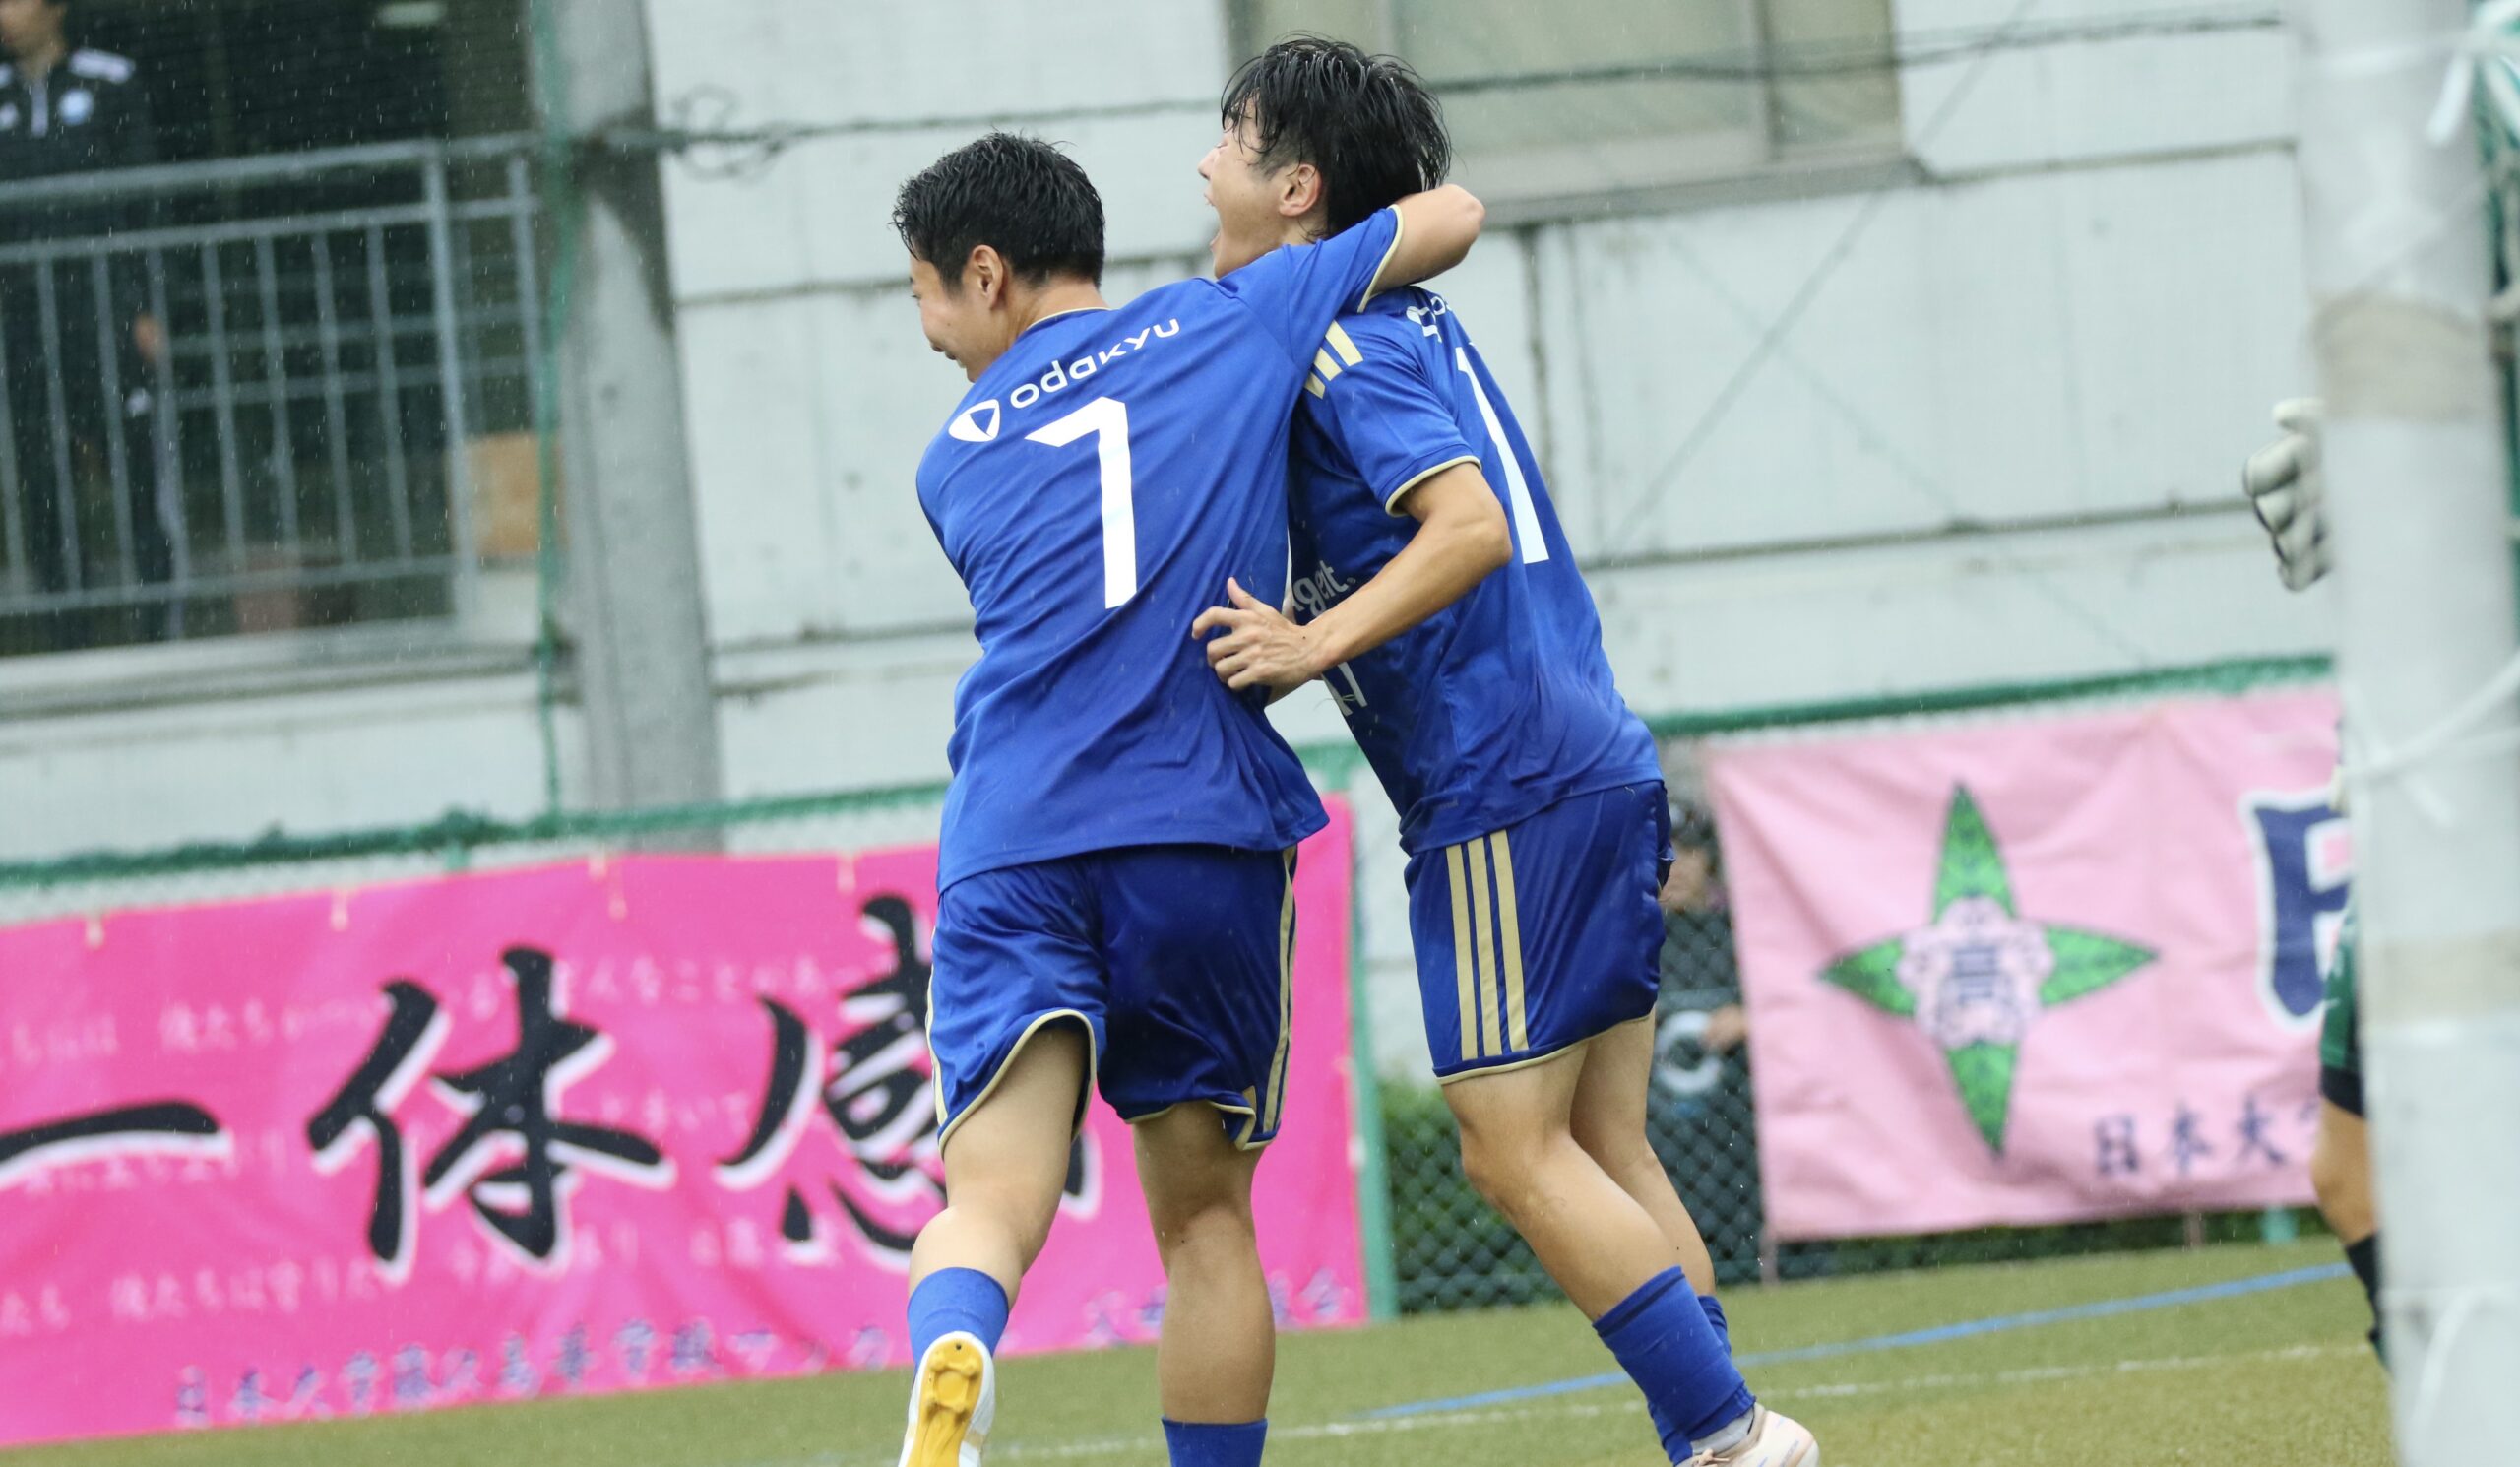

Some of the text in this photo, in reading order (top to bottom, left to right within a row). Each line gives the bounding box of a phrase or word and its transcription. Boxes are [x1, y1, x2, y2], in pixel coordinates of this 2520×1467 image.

[1010, 317, 1181, 410] odakyu
[1454, 344, 1551, 564] 1
[2093, 1095, 2317, 1174] 日本大
